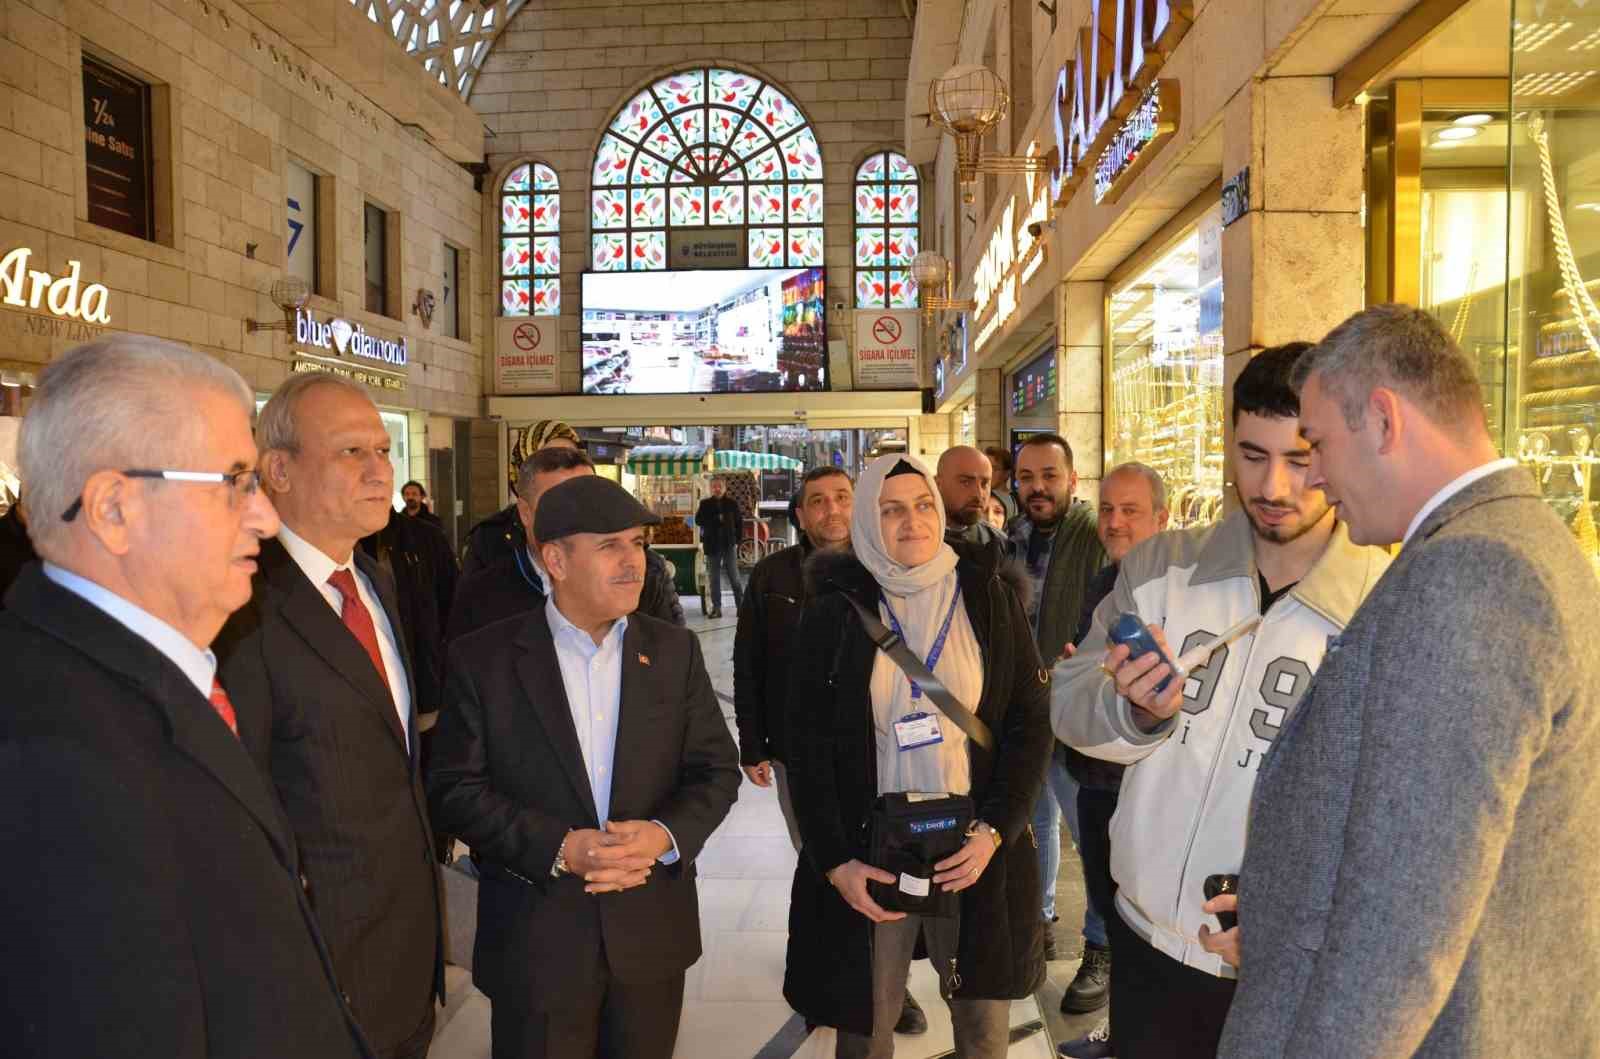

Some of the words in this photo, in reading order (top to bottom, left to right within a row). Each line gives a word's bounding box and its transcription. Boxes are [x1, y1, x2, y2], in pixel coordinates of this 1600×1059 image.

[0, 247, 111, 324] Arda
[296, 307, 332, 349] blue
[351, 324, 407, 364] diamond
[1249, 656, 1313, 742] 9
